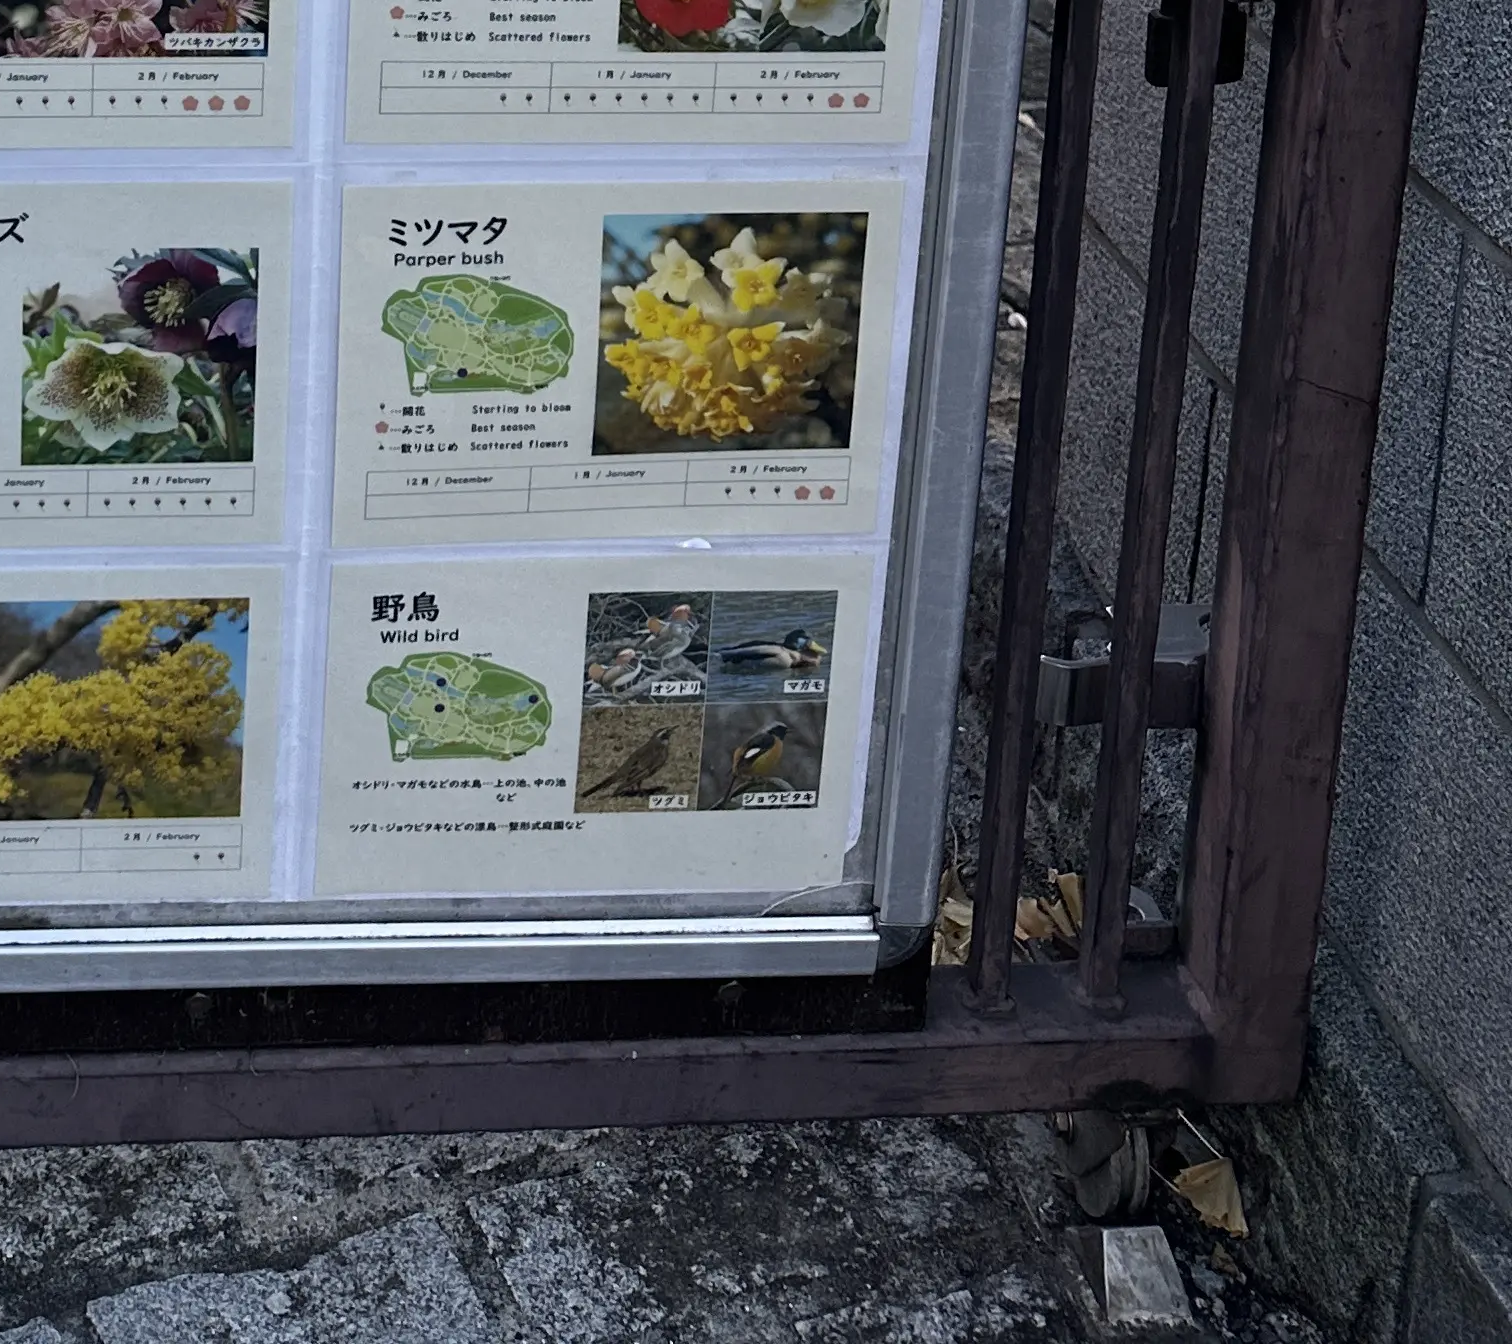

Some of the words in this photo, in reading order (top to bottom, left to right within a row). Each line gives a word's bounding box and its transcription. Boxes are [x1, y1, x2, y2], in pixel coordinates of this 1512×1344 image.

[166, 36, 263, 52] ツバキカンザクラ
[388, 216, 508, 247] ミツマタ
[394, 252, 457, 268] Parper
[461, 250, 504, 265] bush
[370, 591, 440, 624] 野鳥
[380, 629, 419, 644] Wild
[424, 628, 459, 643] bird
[653, 682, 699, 694] オシドリ
[787, 680, 823, 691] マガモ
[495, 792, 517, 803] など
[652, 795, 685, 807] ツグミ
